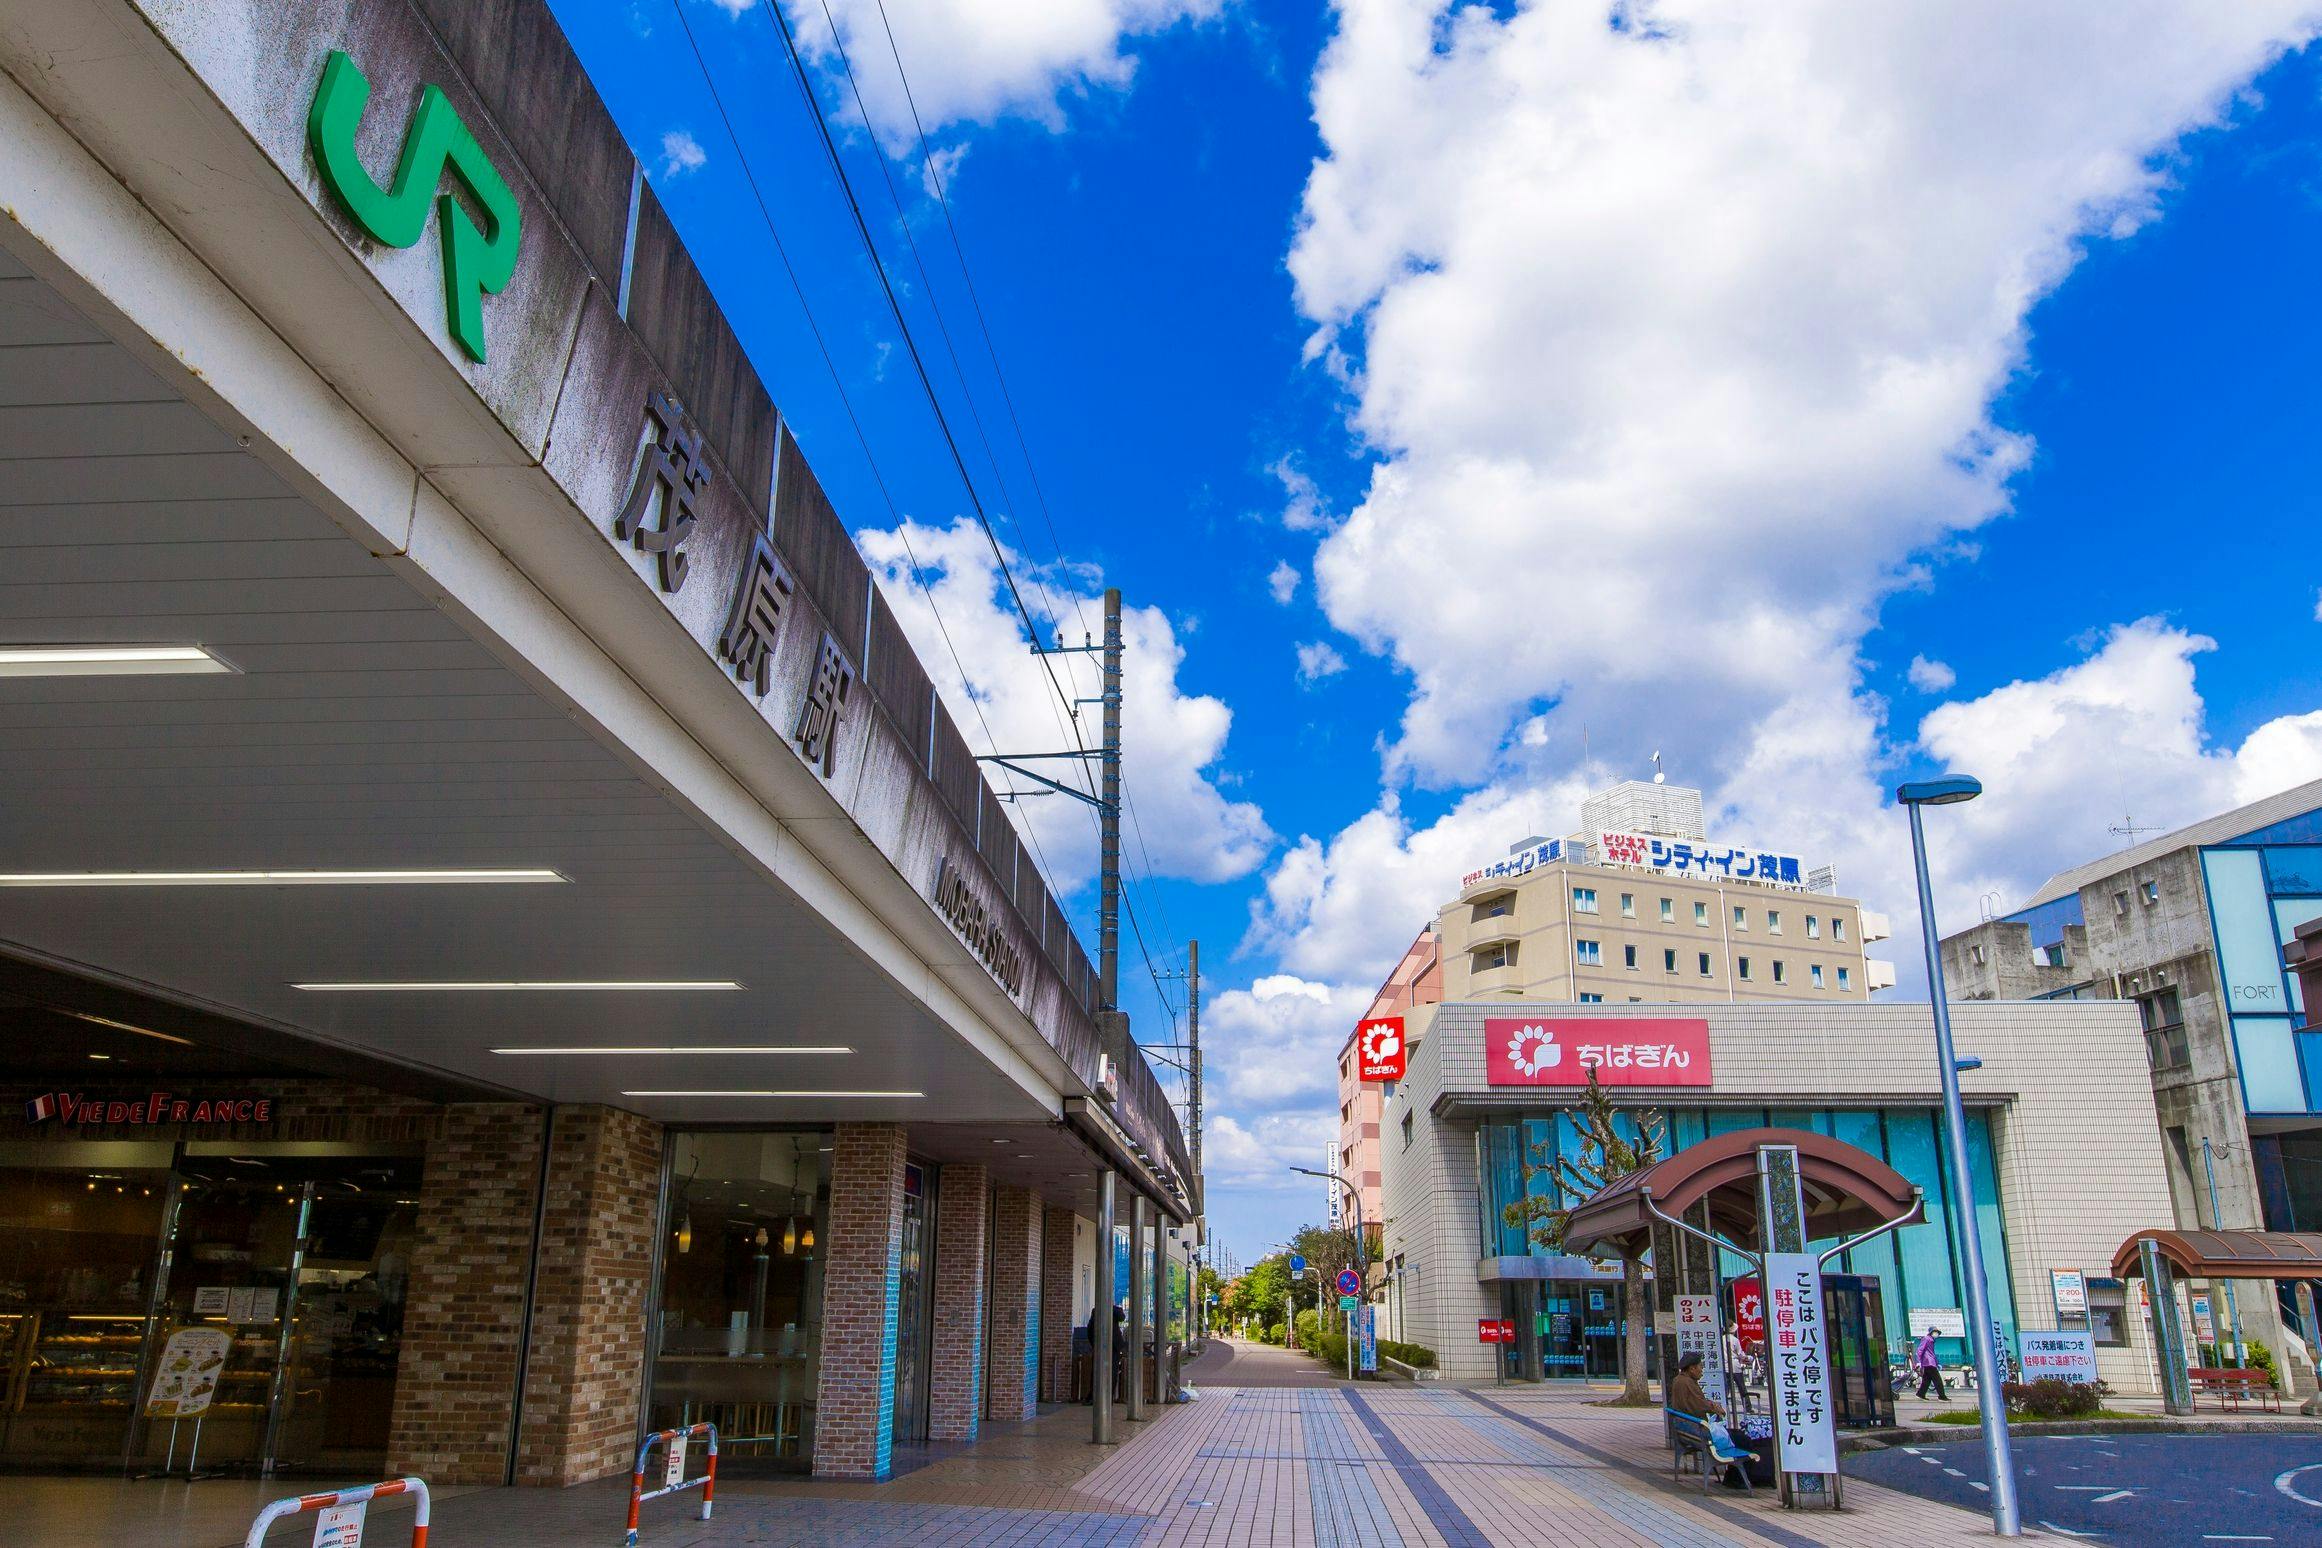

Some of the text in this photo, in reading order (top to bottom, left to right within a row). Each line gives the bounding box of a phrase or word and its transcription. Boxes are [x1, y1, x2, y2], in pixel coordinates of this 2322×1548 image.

[309, 50, 521, 364] JR
[615, 392, 855, 779] 茂原駅
[1603, 833, 1648, 852] ビジネス
[1608, 849, 1642, 864] ホテル
[935, 857, 990, 954] MOBARA
[2233, 985, 2278, 999] FORT
[1576, 1044, 1690, 1068] ちばぎん
[1364, 1065, 1398, 1075] ちばぎん
[1796, 1271, 1824, 1425] ここはバス停です
[2027, 1340, 2085, 1351] バス発着場につき
[1774, 1288, 1804, 1447] 駐停車できません
